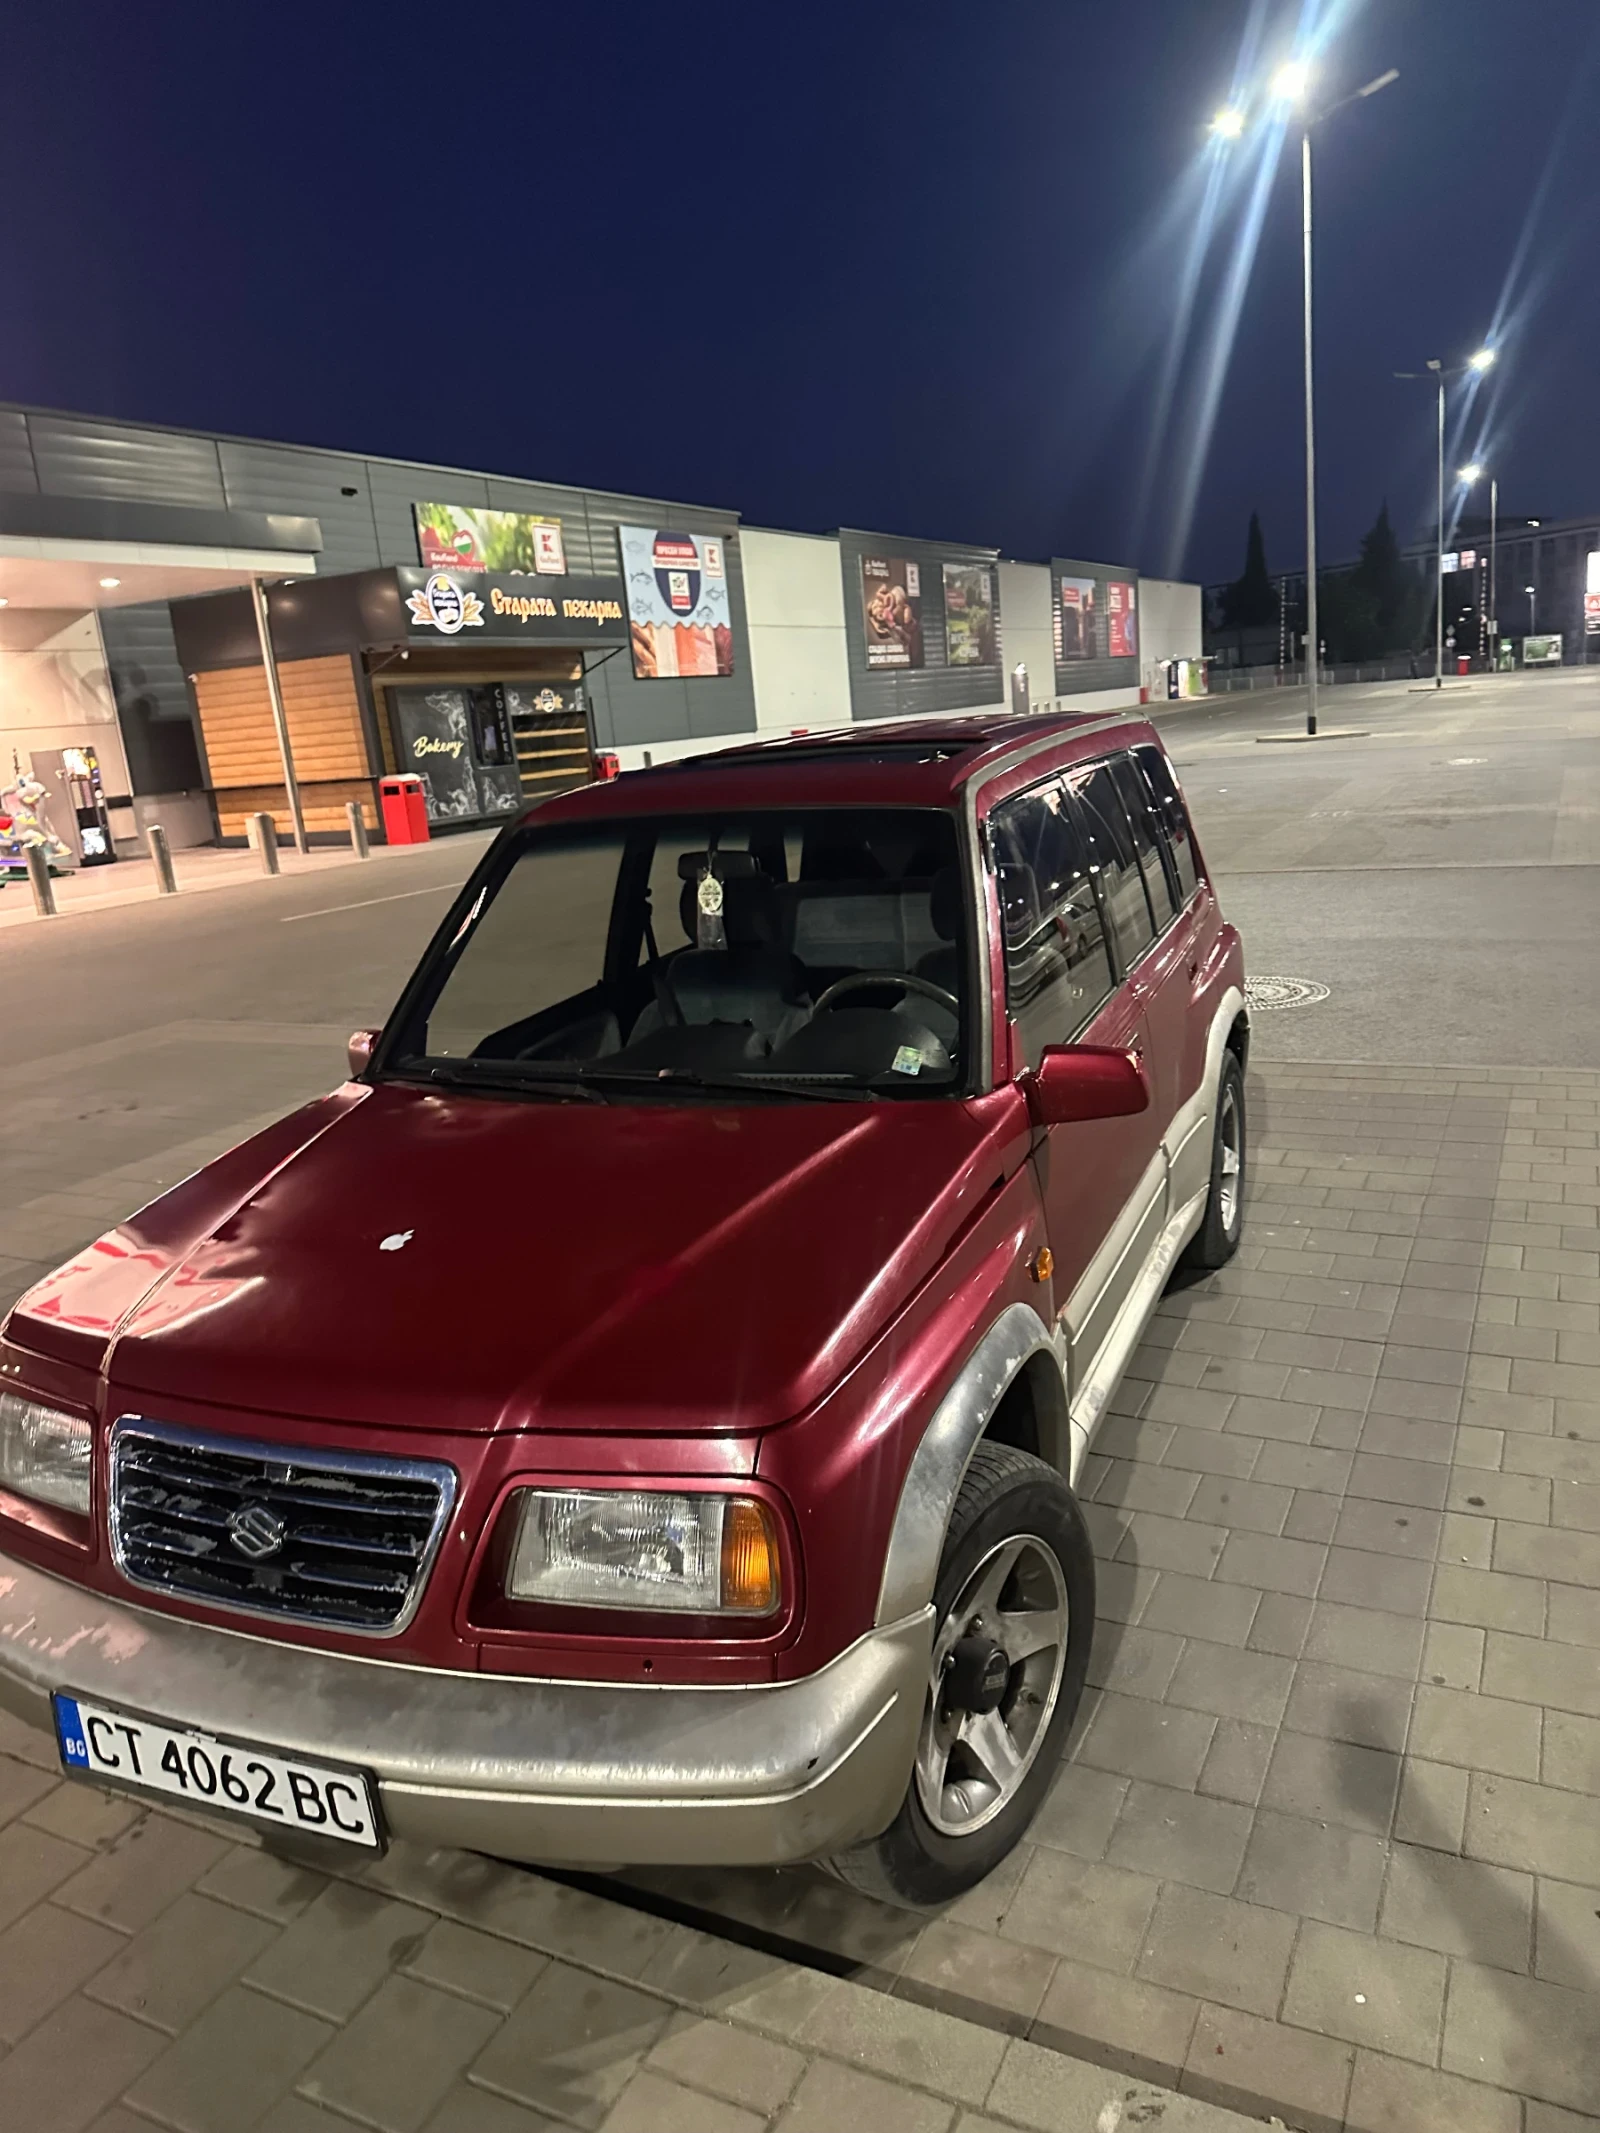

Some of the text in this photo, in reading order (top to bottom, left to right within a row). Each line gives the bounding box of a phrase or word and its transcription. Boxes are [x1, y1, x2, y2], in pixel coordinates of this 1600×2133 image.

[490, 587, 623, 626] Старата пекарна
[412, 735, 465, 758] Bakery
[65, 1736, 87, 1758] BG
[86, 1716, 365, 1834] CT 4062 BC
